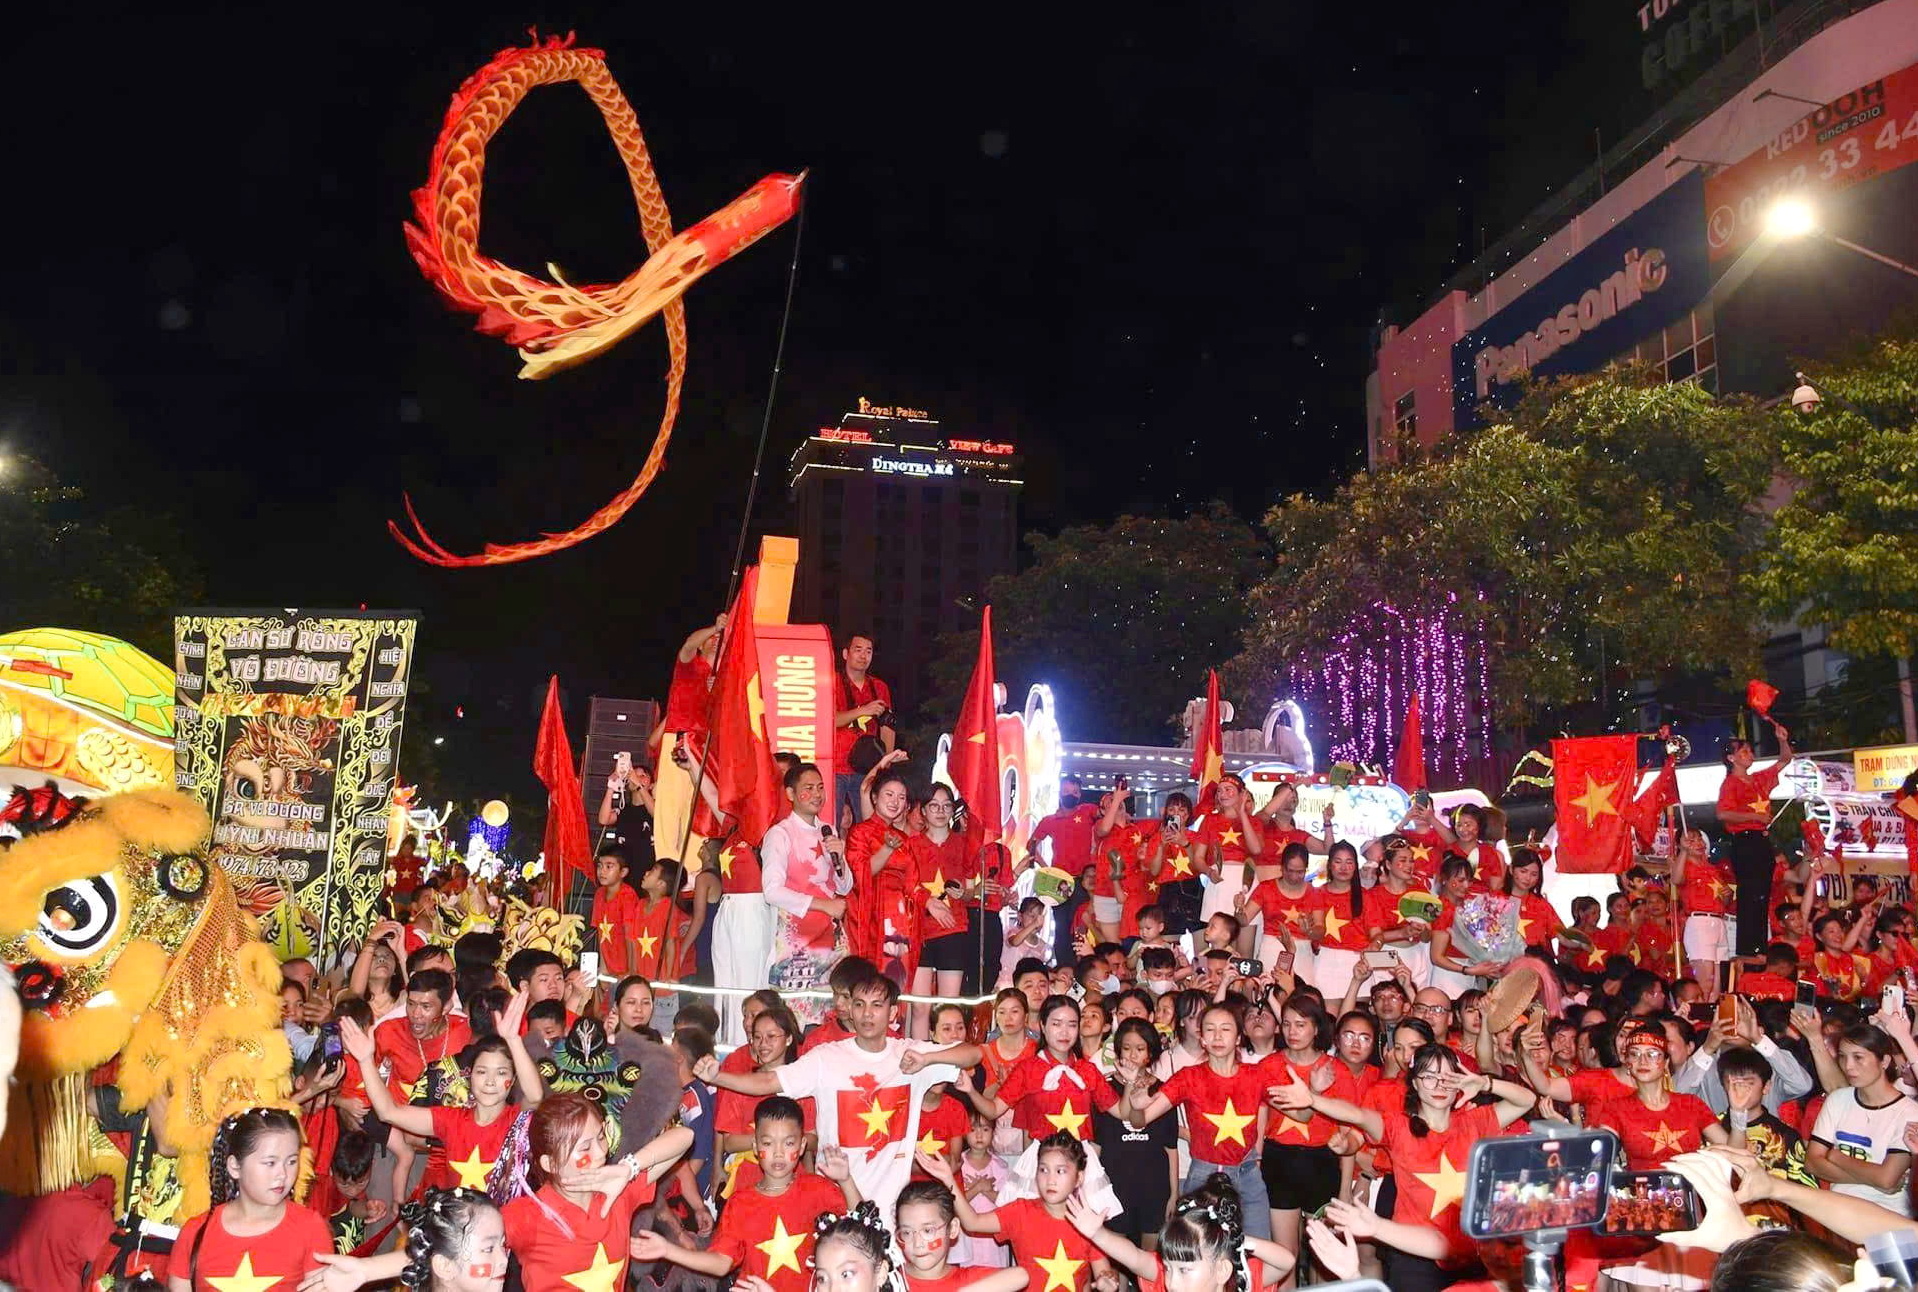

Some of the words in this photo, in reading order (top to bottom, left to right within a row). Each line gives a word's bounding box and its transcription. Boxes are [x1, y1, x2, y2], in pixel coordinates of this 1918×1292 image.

[1817, 122, 1849, 143] since
[1852, 107, 1881, 127] 2010
[1818, 138, 1862, 181] 33
[859, 397, 893, 416] Royal
[820, 428, 873, 443] HOTEL
[774, 655, 817, 717] HƯNG
[1121, 1132, 1150, 1141] adidas
